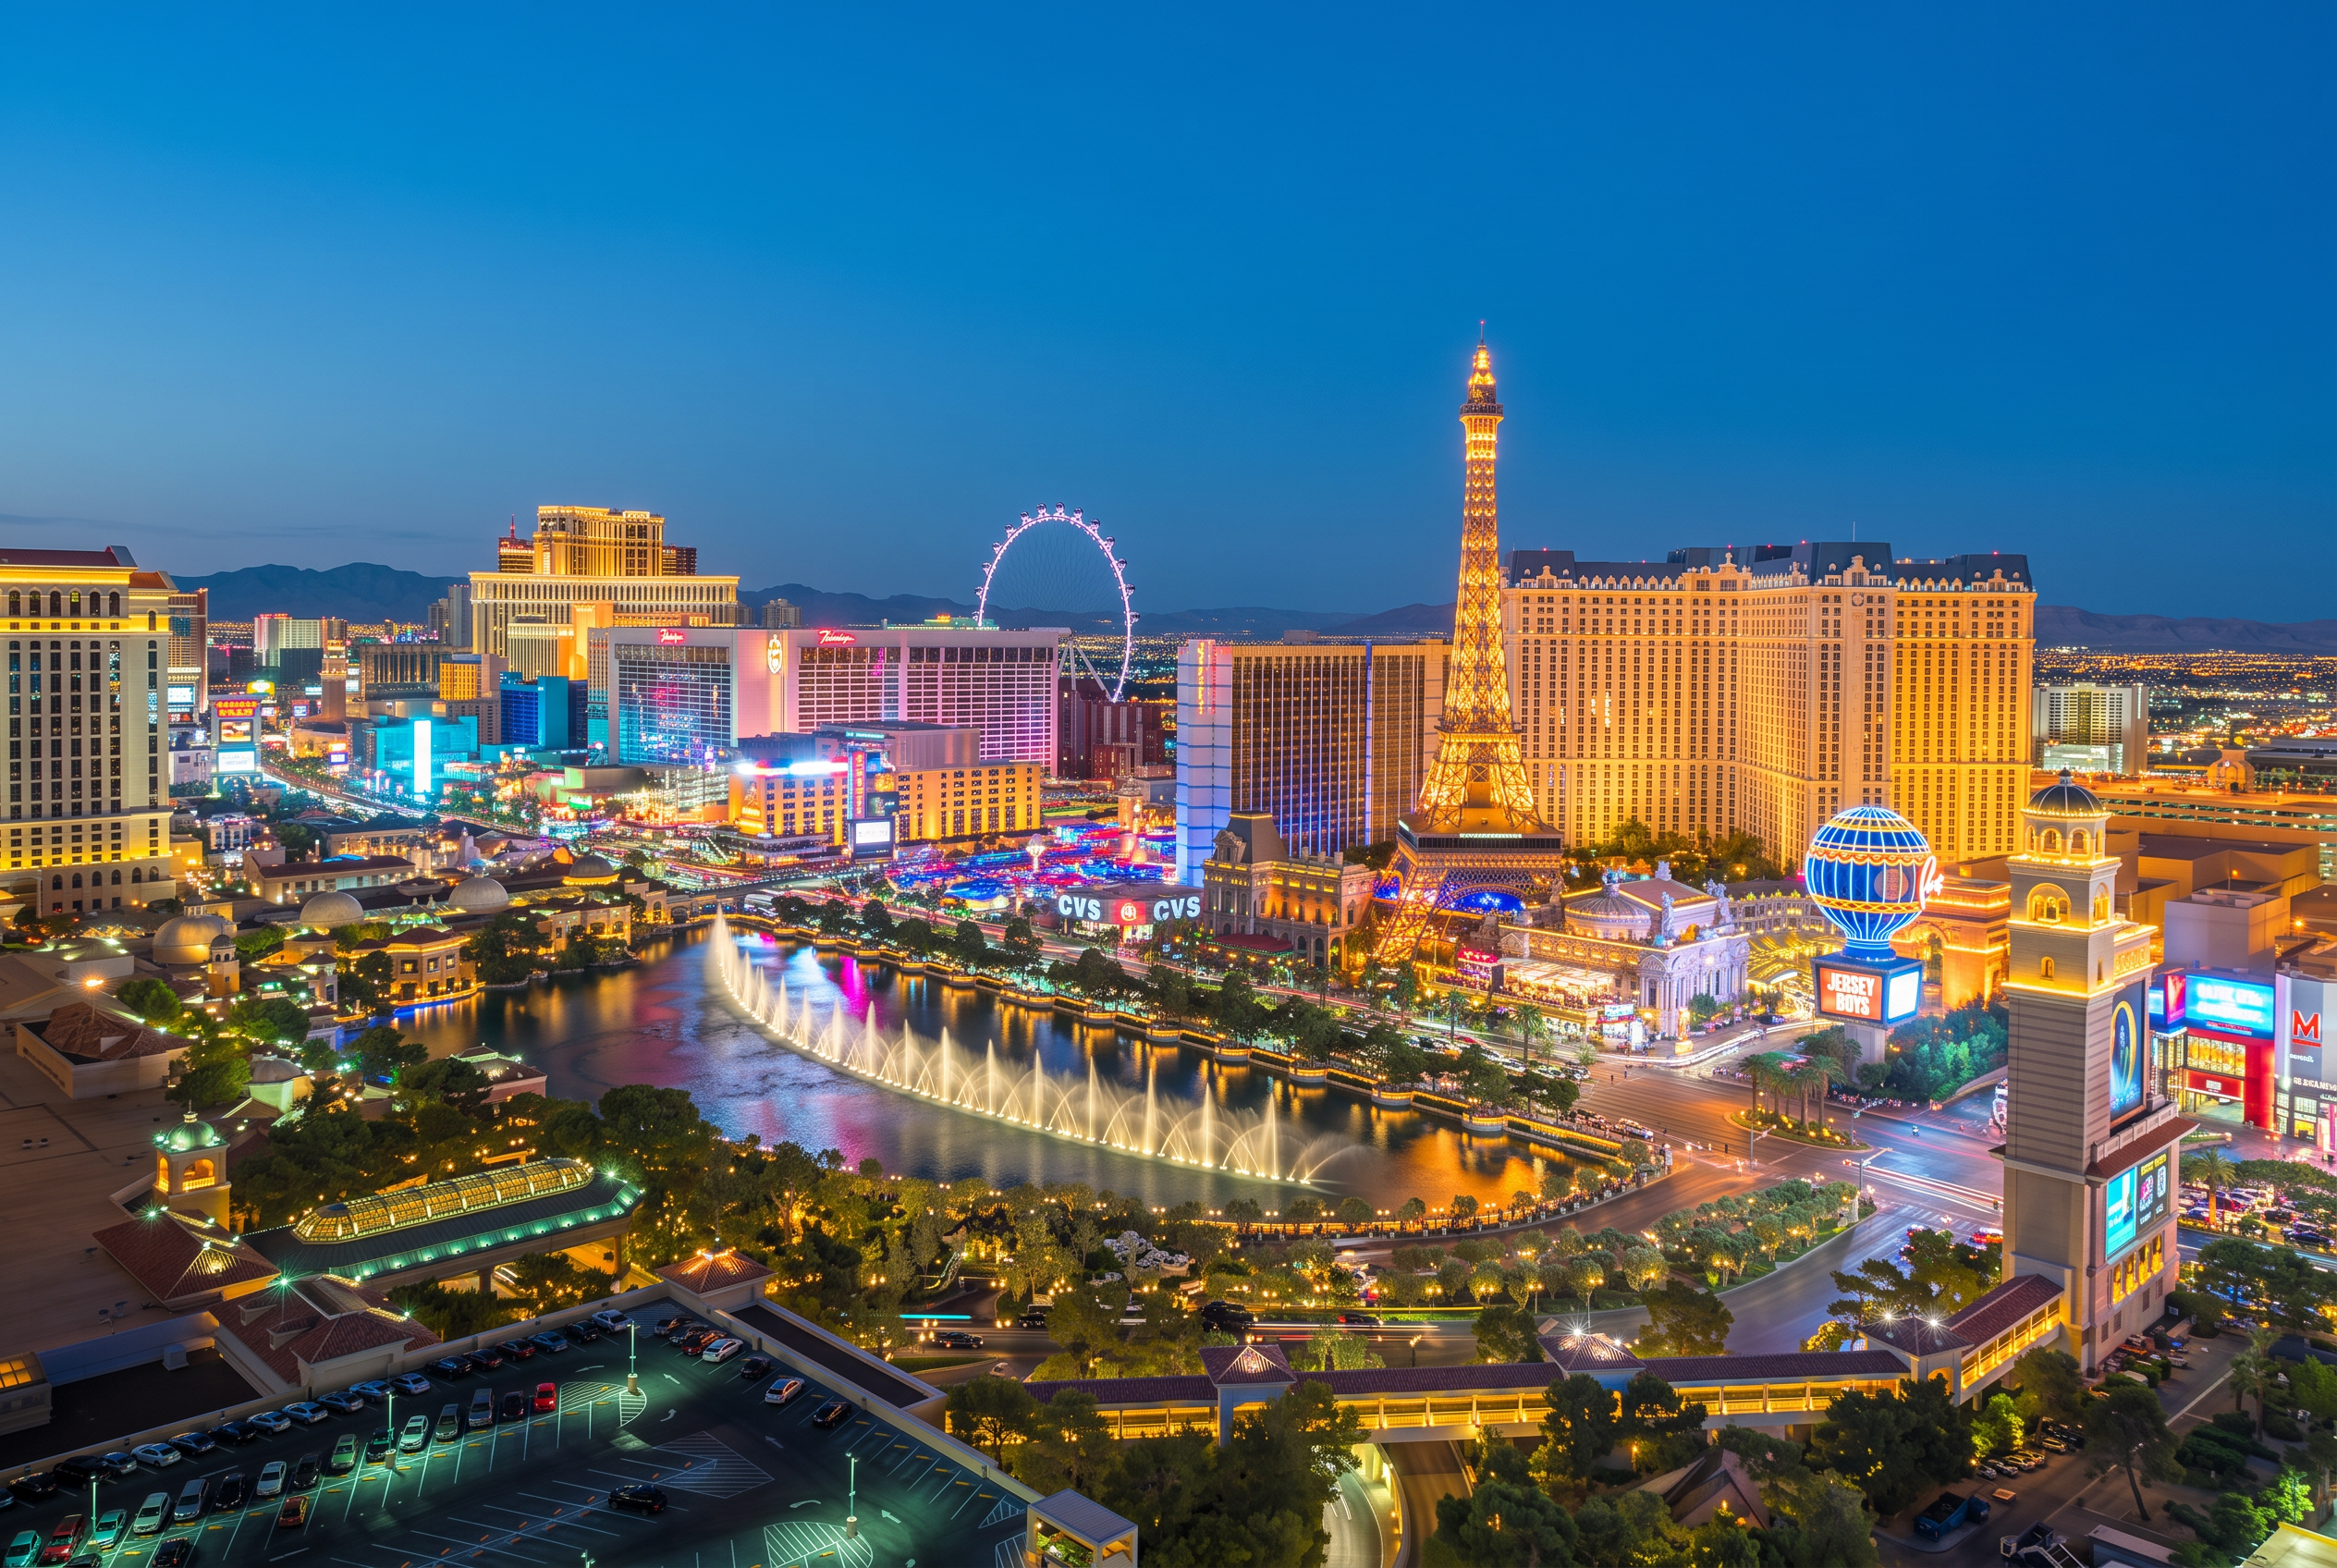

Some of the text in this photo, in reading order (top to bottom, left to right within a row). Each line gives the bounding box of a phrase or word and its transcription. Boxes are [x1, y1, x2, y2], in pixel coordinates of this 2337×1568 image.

[1058, 894, 1101, 921] CVS
[1153, 896, 1201, 921] CVS
[1827, 972, 1876, 997] JERSEY
[1835, 992, 1870, 1016] BOYS
[2292, 1009, 2321, 1040] M
